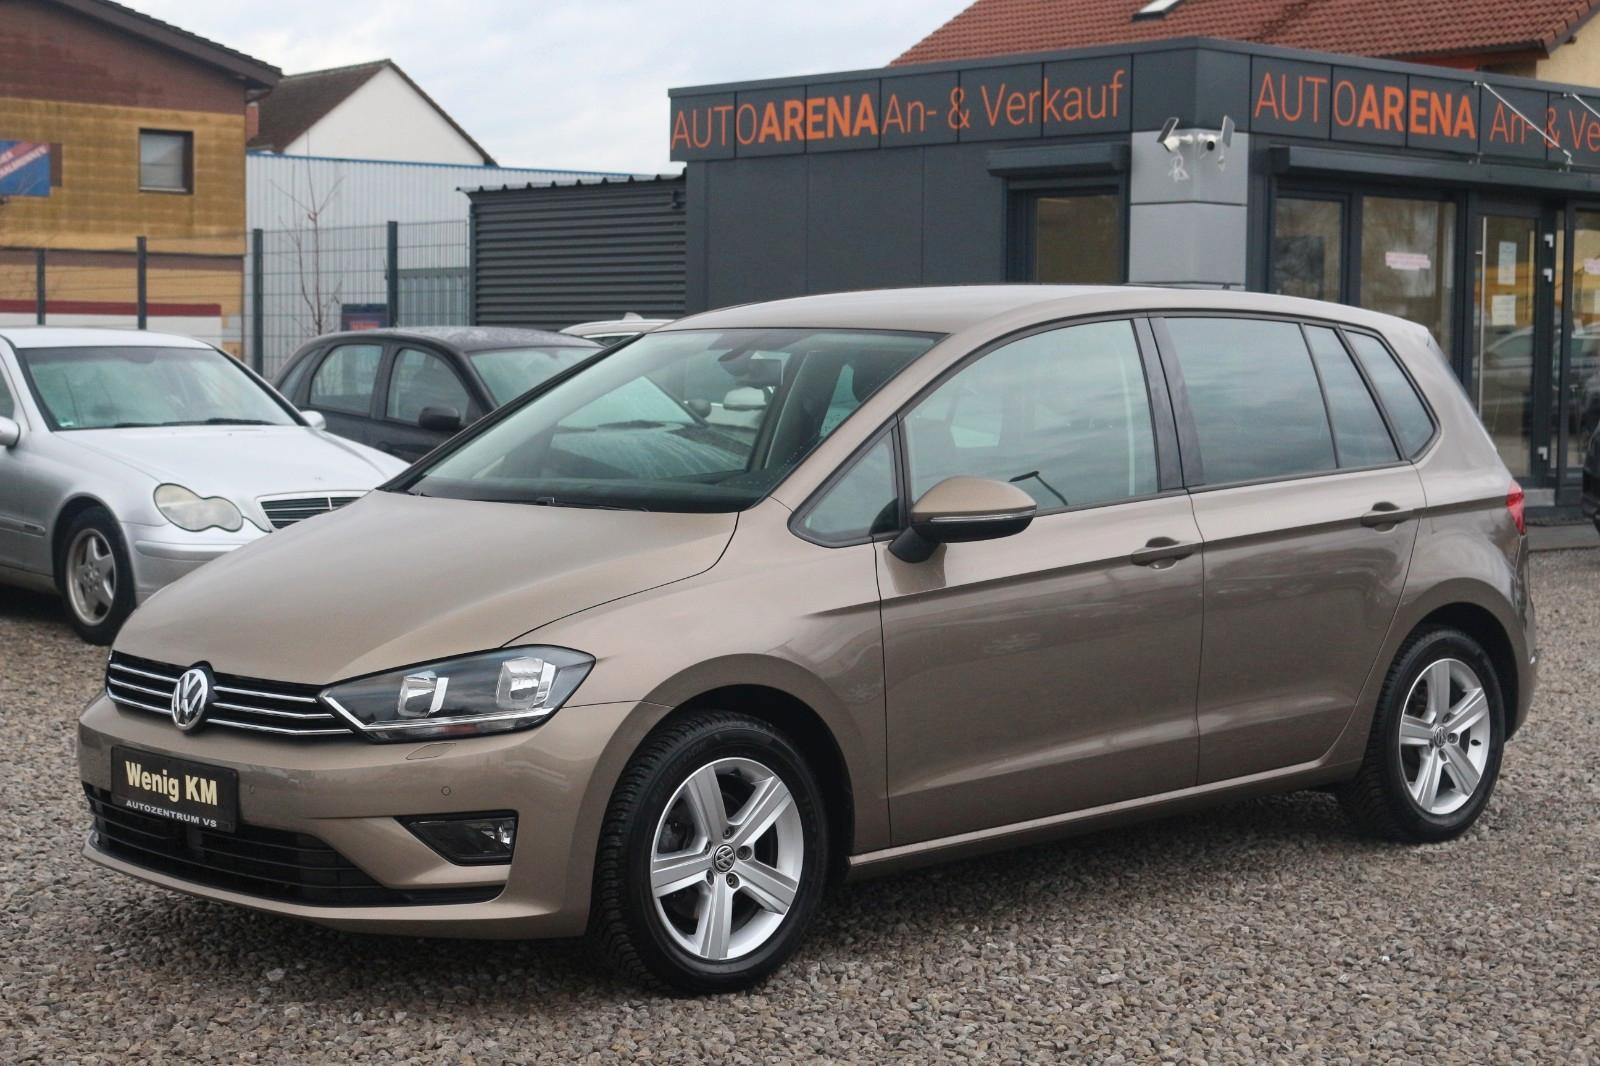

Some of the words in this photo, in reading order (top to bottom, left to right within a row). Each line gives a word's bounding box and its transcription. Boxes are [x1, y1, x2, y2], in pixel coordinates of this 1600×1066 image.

[671, 93, 878, 150] AUTOARENA
[881, 93, 937, 134] An-
[947, 86, 971, 130] &
[981, 69, 1125, 127] Verkauf
[1254, 72, 1477, 140] AUTOARENA
[1543, 106, 1561, 150] &
[125, 760, 180, 803] Wenig
[185, 774, 218, 806] KM
[126, 800, 200, 825] AUTOZENTRUM
[202, 817, 217, 828] VS
